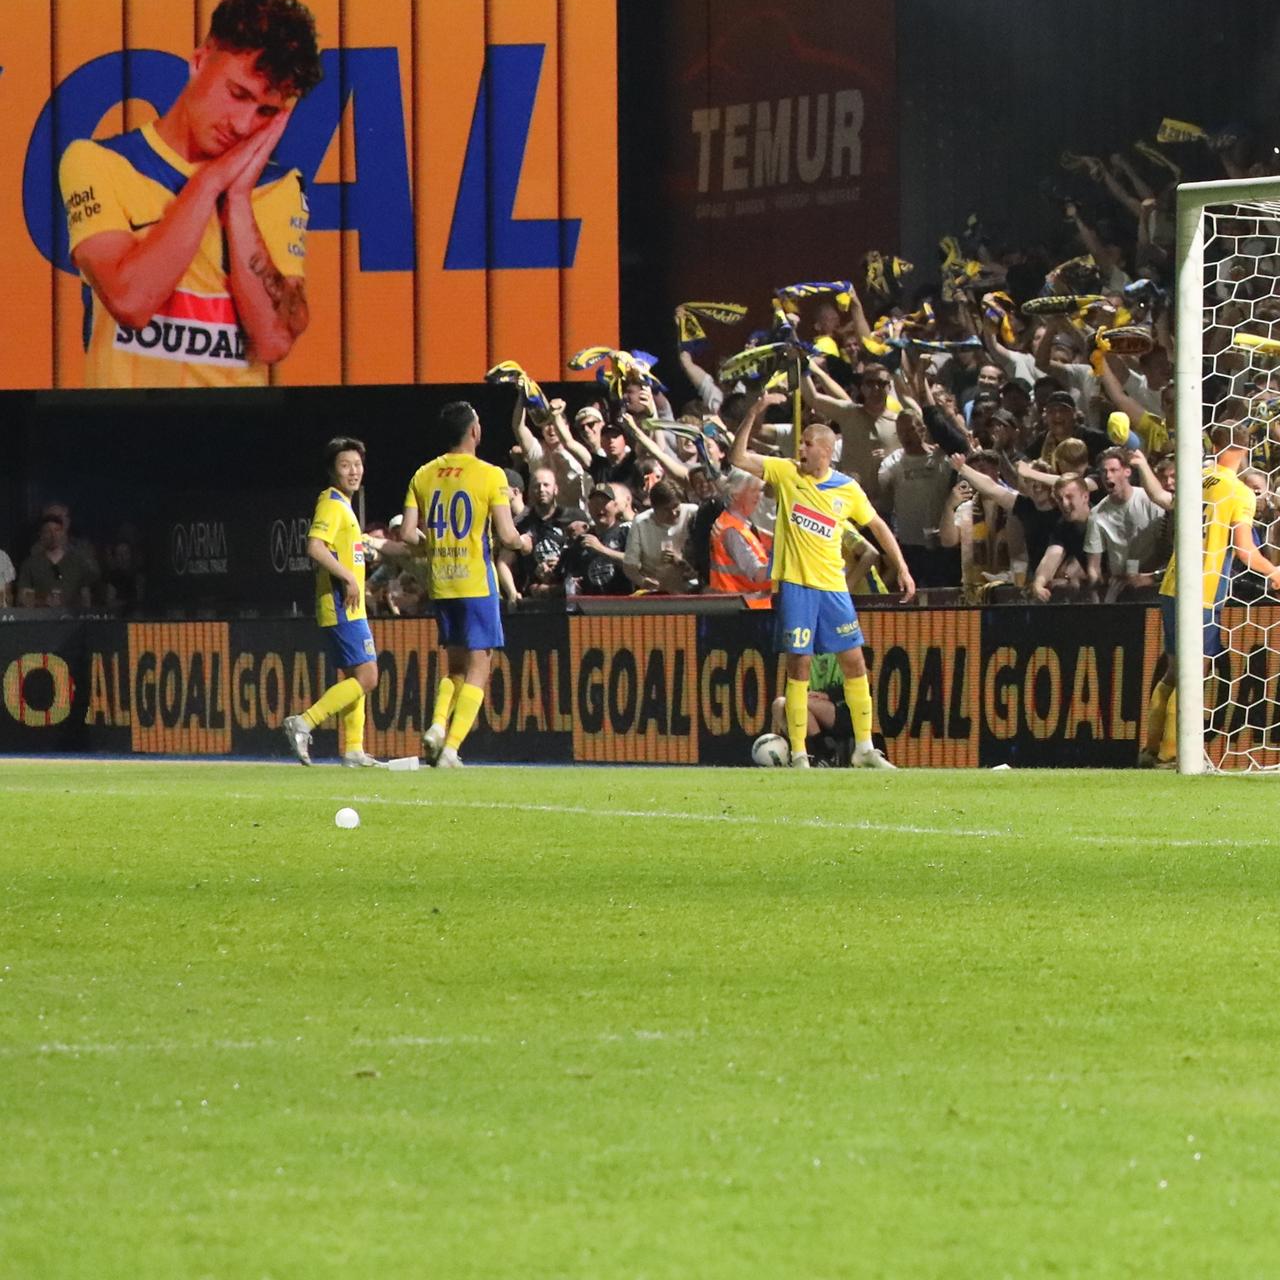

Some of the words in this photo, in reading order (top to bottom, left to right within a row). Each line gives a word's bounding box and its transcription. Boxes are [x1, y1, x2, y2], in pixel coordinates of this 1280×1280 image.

[691, 88, 865, 193] TEMUR
[426, 489, 473, 540] 40
[790, 512, 832, 539] SOUDAL
[792, 626, 811, 648] 19
[136, 650, 226, 731] GOAL
[483, 648, 572, 733] OAL
[577, 647, 692, 736] GOAL
[862, 646, 973, 739] OAL
[984, 646, 1140, 741] GOAL
